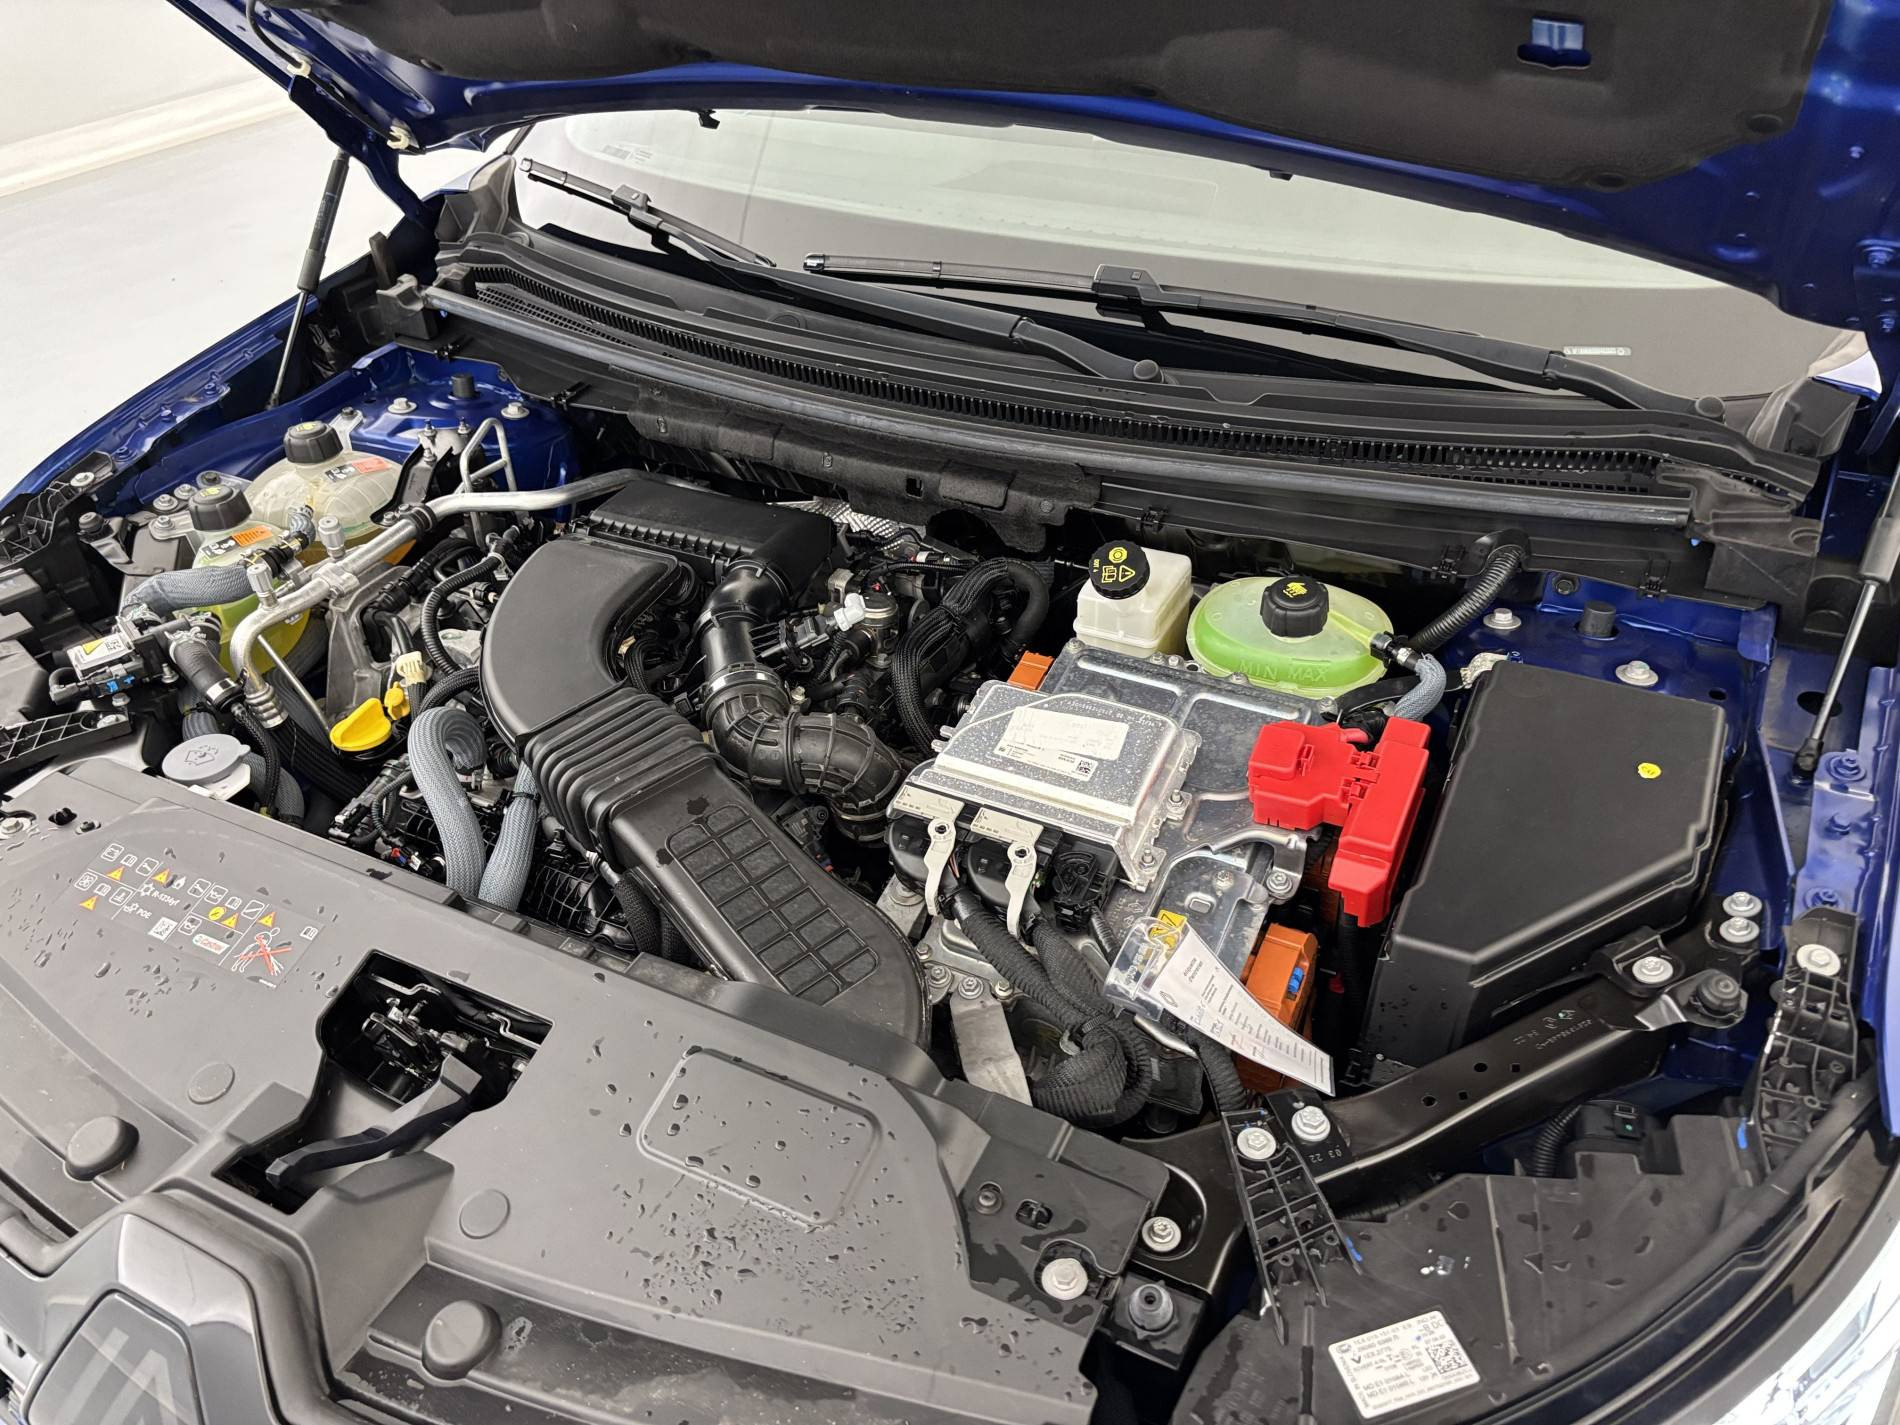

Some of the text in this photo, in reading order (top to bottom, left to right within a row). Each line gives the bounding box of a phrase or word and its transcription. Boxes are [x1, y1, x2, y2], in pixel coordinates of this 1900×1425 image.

[1240, 660, 1328, 682] MIN MAX
[136, 908, 152, 919] POE
